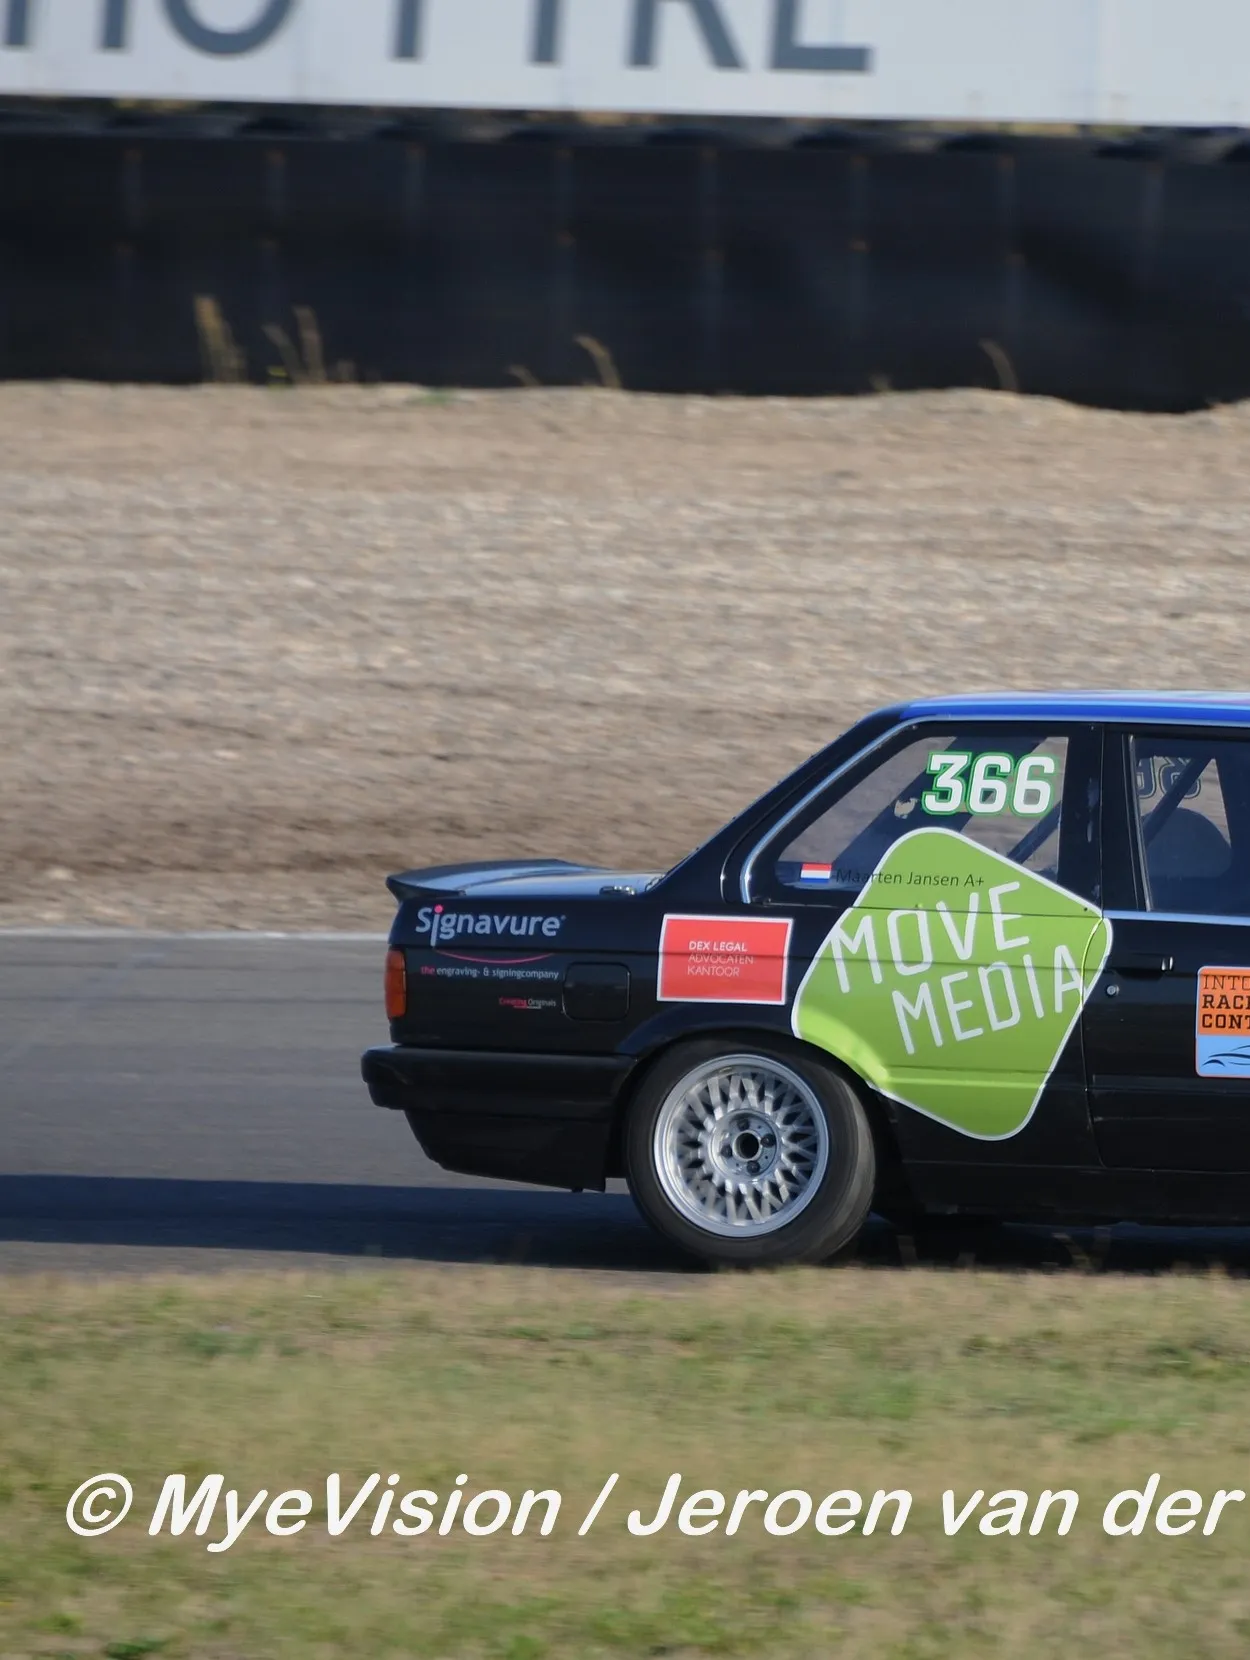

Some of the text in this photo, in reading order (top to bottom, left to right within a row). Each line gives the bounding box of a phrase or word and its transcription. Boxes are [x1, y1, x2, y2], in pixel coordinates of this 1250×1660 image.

[922, 751, 1059, 817] 366
[906, 871, 959, 886] Jansen
[415, 904, 562, 947] Signavure
[828, 881, 1030, 994] MOVE
[688, 940, 748, 953] DEX LEGAL
[687, 953, 755, 965] ADVOCATEN
[420, 965, 435, 976] the
[687, 965, 740, 977] KANTOOR
[891, 944, 1088, 1055] MEDIA
